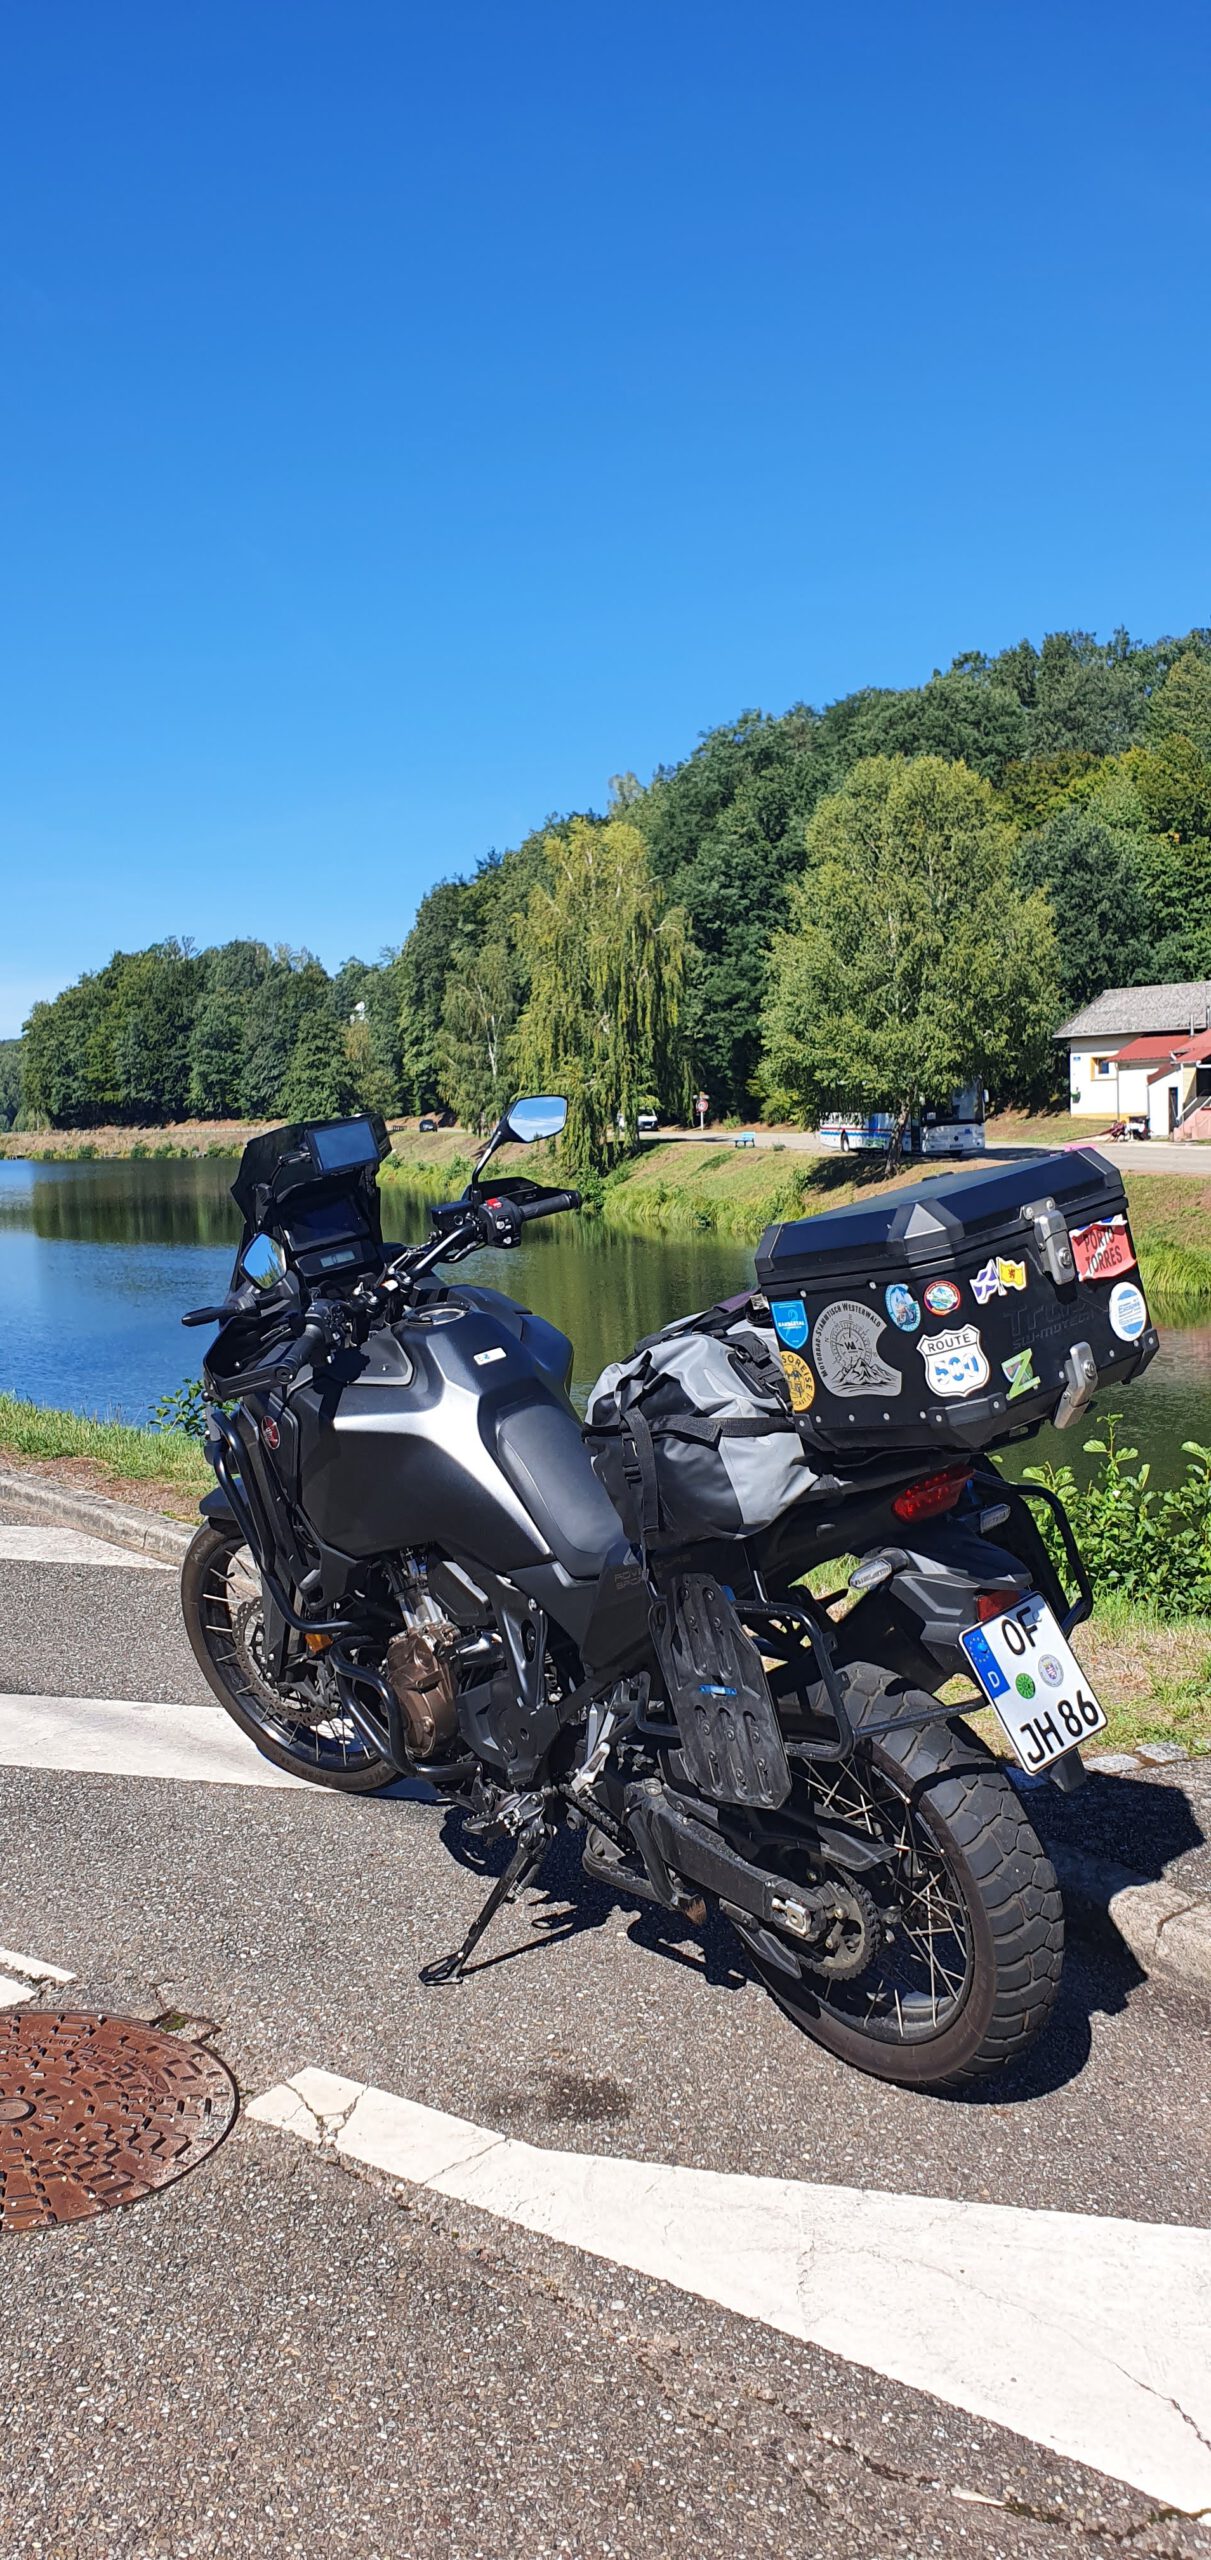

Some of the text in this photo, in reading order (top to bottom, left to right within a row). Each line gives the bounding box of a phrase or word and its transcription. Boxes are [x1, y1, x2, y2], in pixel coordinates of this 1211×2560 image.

[1084, 1226, 1115, 1252] PORTO
[1085, 1245, 1123, 1274] TORRES
[927, 1333, 972, 1353] ROUTE
[781, 1354, 812, 1390] SOREISE
[1001, 1606, 1038, 1655] OF
[987, 1671, 1001, 1688] D
[1019, 1690, 1099, 1764] JH 86
